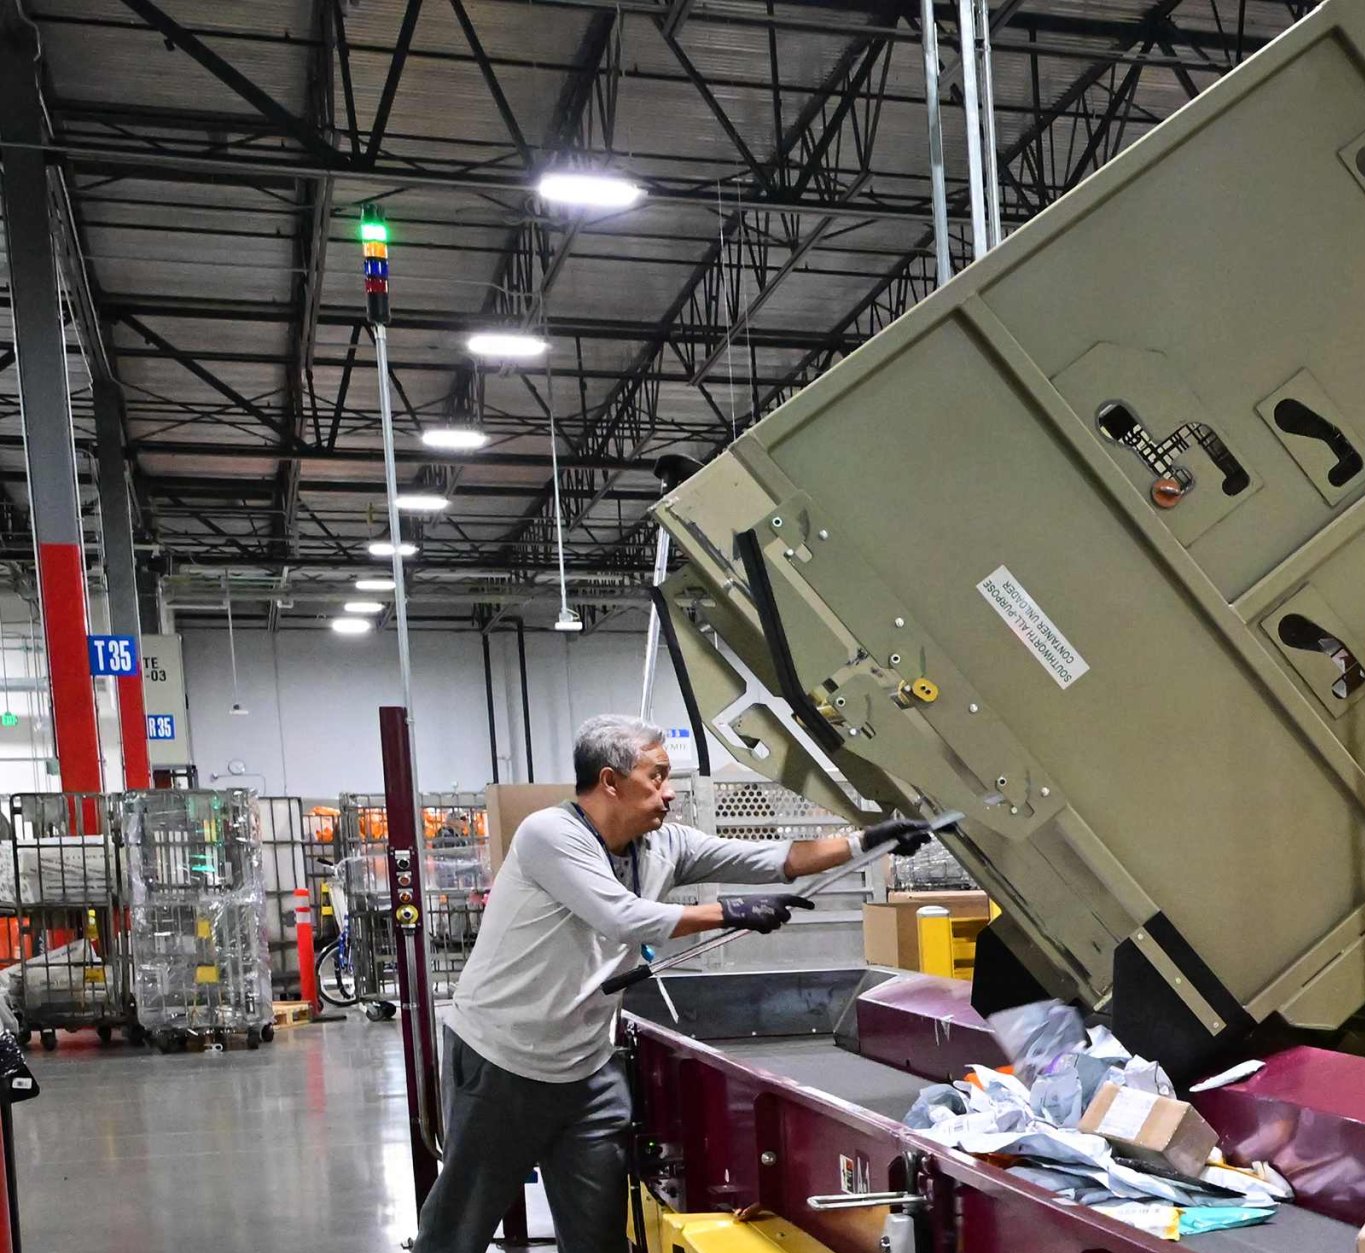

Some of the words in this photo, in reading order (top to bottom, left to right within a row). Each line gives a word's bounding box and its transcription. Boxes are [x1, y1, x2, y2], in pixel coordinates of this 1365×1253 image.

[982, 579, 1029, 631] ALL-PURPOSE
[1002, 580, 1040, 623] UNLOADER
[94, 640, 105, 671] T
[108, 640, 131, 671] 35
[1026, 628, 1072, 682] SOUTHWORTH
[1036, 620, 1074, 664] CONTAINER
[149, 717, 156, 737] R
[157, 717, 171, 737] 35
